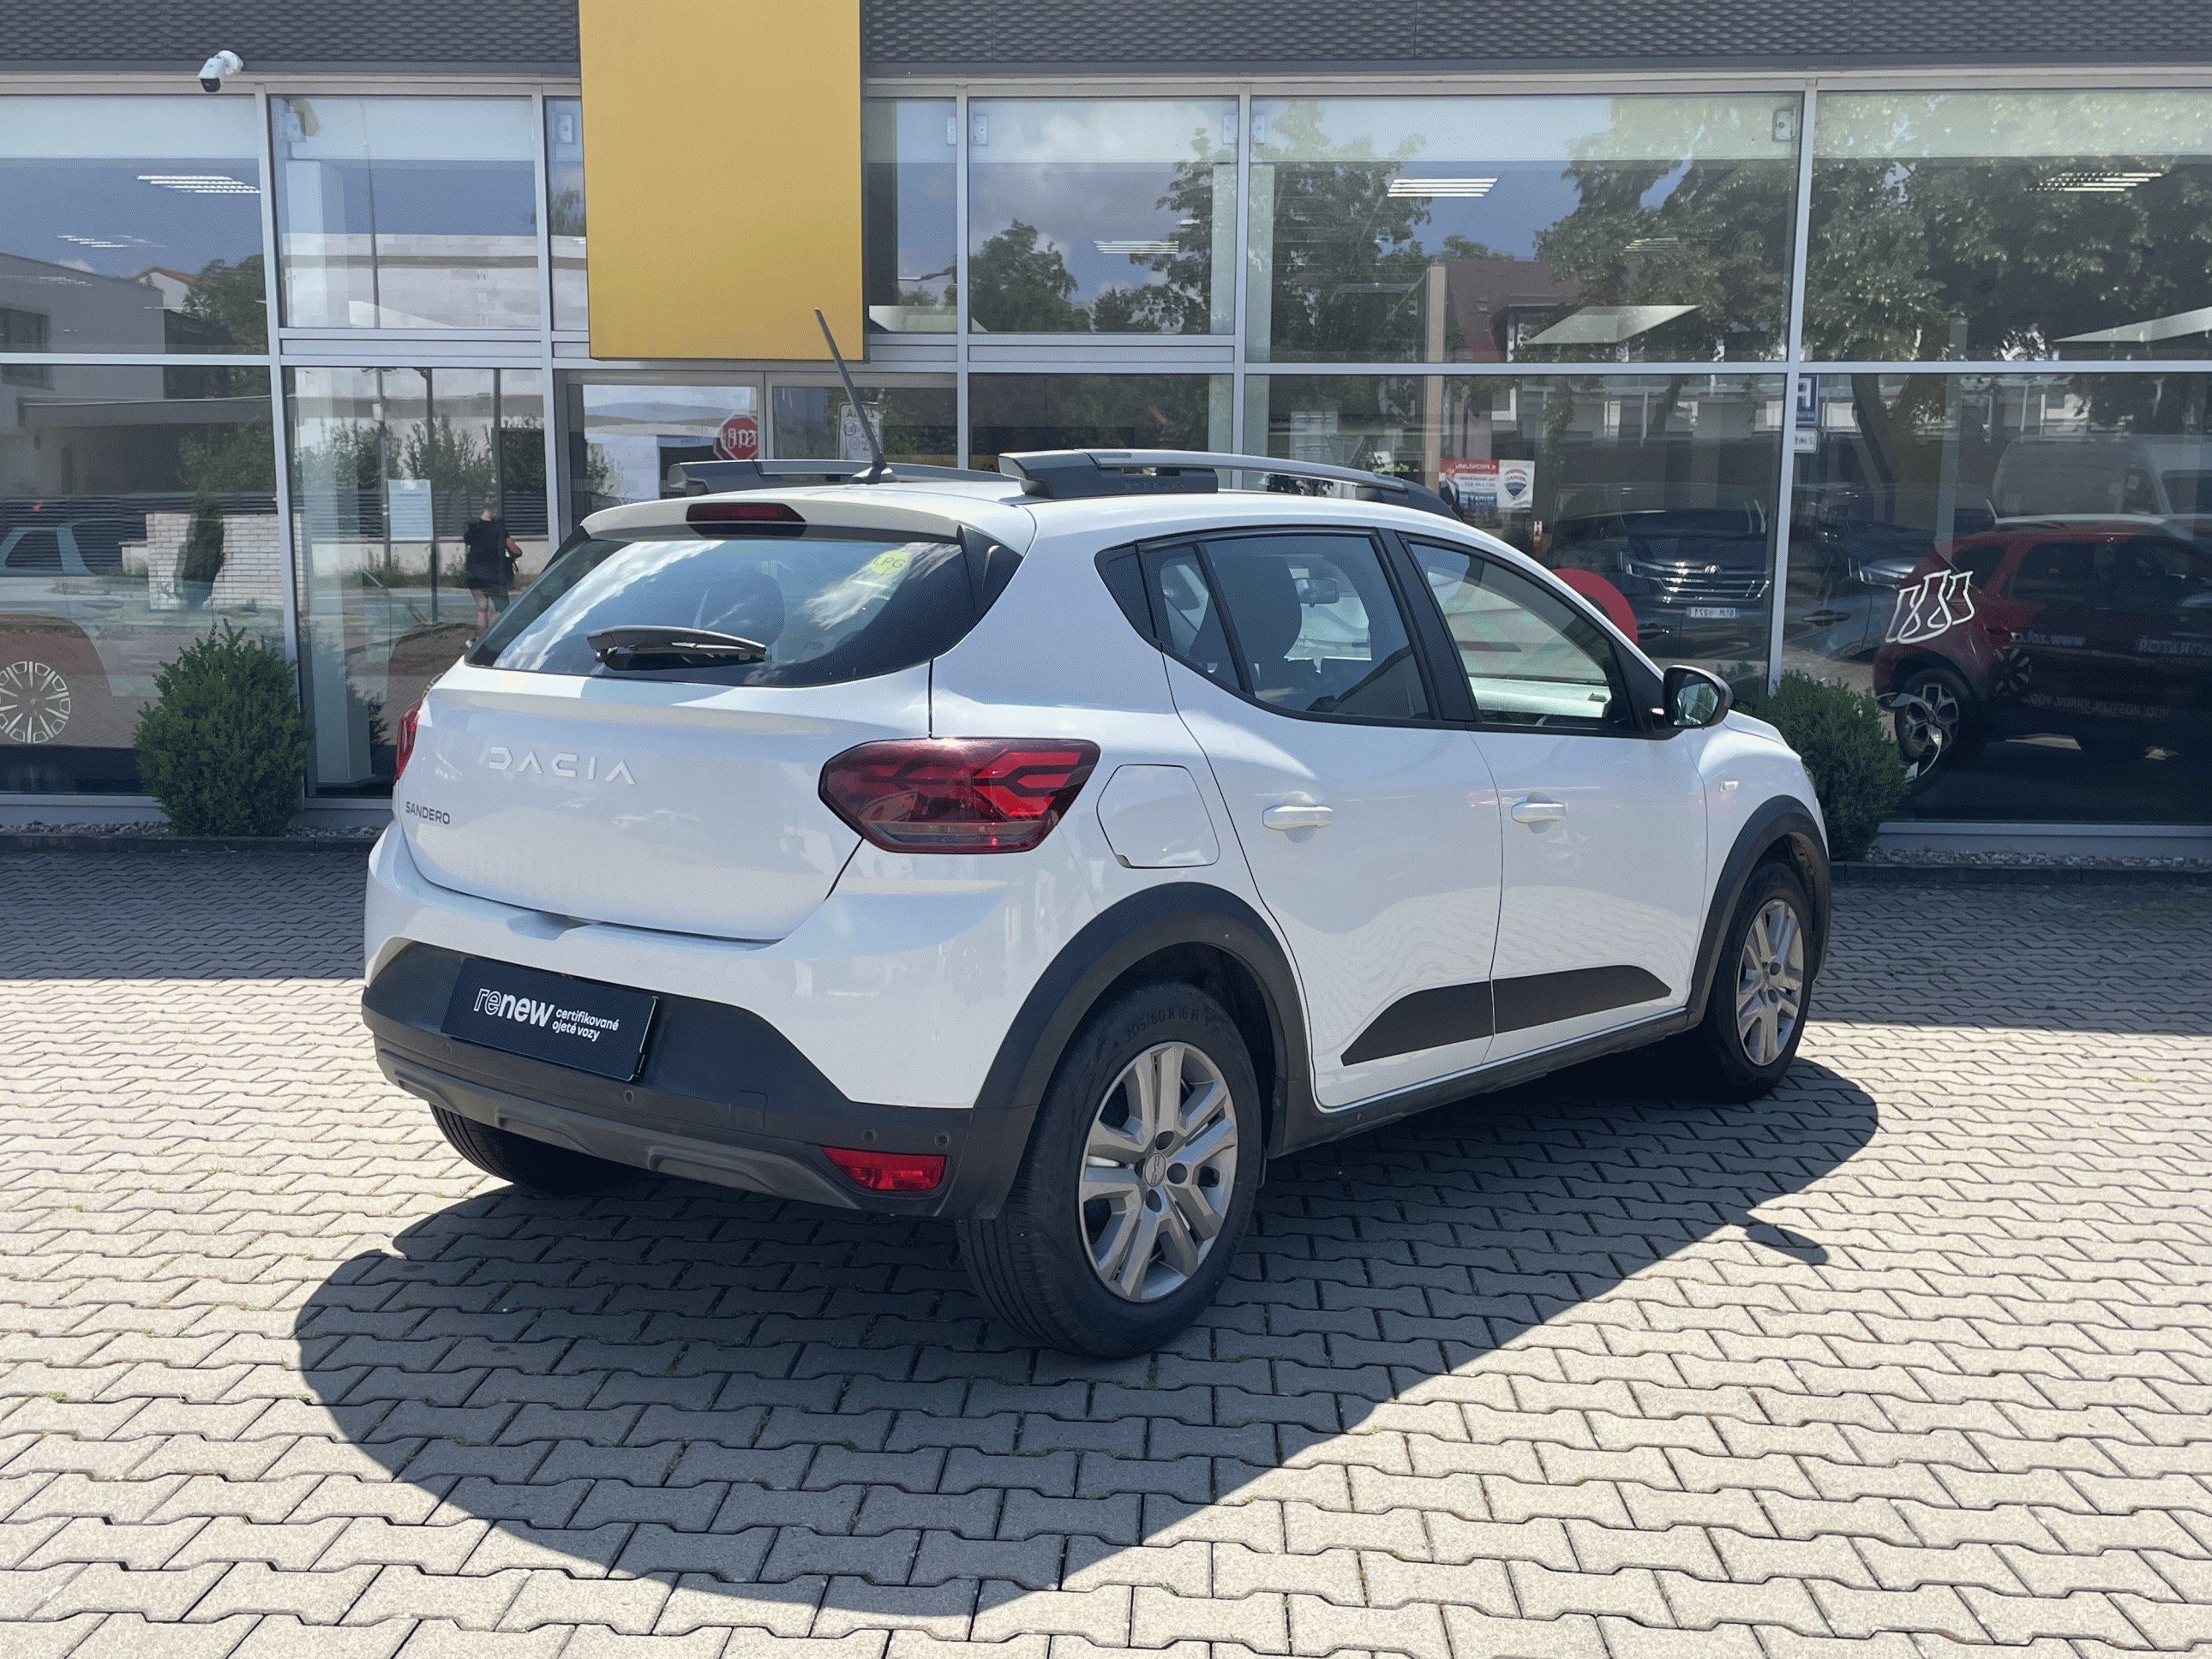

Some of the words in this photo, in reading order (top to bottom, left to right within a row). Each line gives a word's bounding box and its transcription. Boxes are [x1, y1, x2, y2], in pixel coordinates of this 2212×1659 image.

[873, 556, 906, 568] LPG
[488, 746, 637, 785] DACIA
[405, 801, 450, 825] SANDERO
[474, 988, 554, 1027] renew
[552, 1021, 577, 1033] ojeté
[578, 1026, 600, 1042] vozy
[556, 1009, 620, 1031] certifikované
[1124, 1009, 1166, 1042] 205/60
[1168, 1008, 1175, 1020] R
[1178, 1006, 1188, 1020] 16
[1191, 1008, 1198, 1021] H
